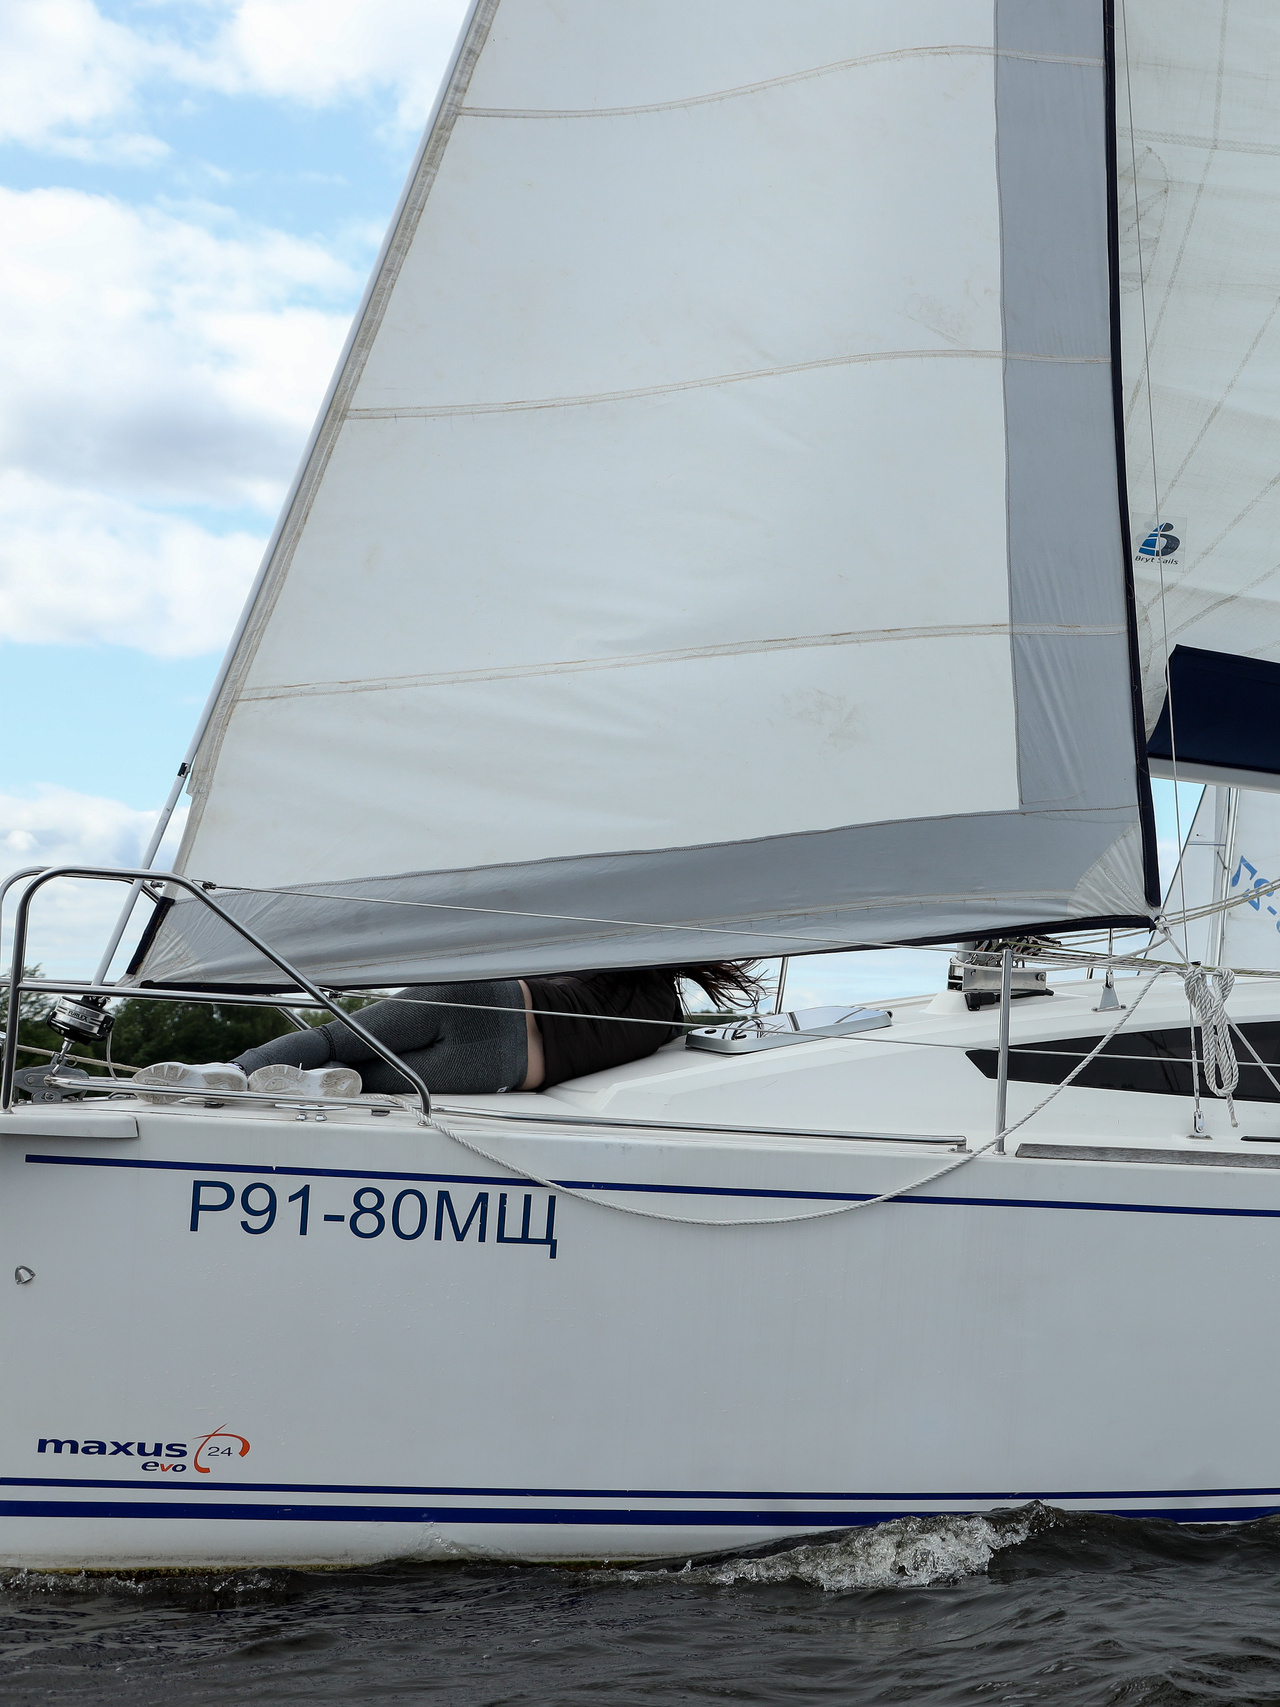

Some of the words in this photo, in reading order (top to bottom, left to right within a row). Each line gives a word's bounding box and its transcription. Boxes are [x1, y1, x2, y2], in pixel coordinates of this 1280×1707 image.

[1135, 555, 1155, 563] Bryt
[189, 1179, 558, 1260] Р91-80МЩ
[37, 1438, 188, 1459] maxus
[207, 1446, 233, 1457] 24
[141, 1460, 187, 1473] evo
